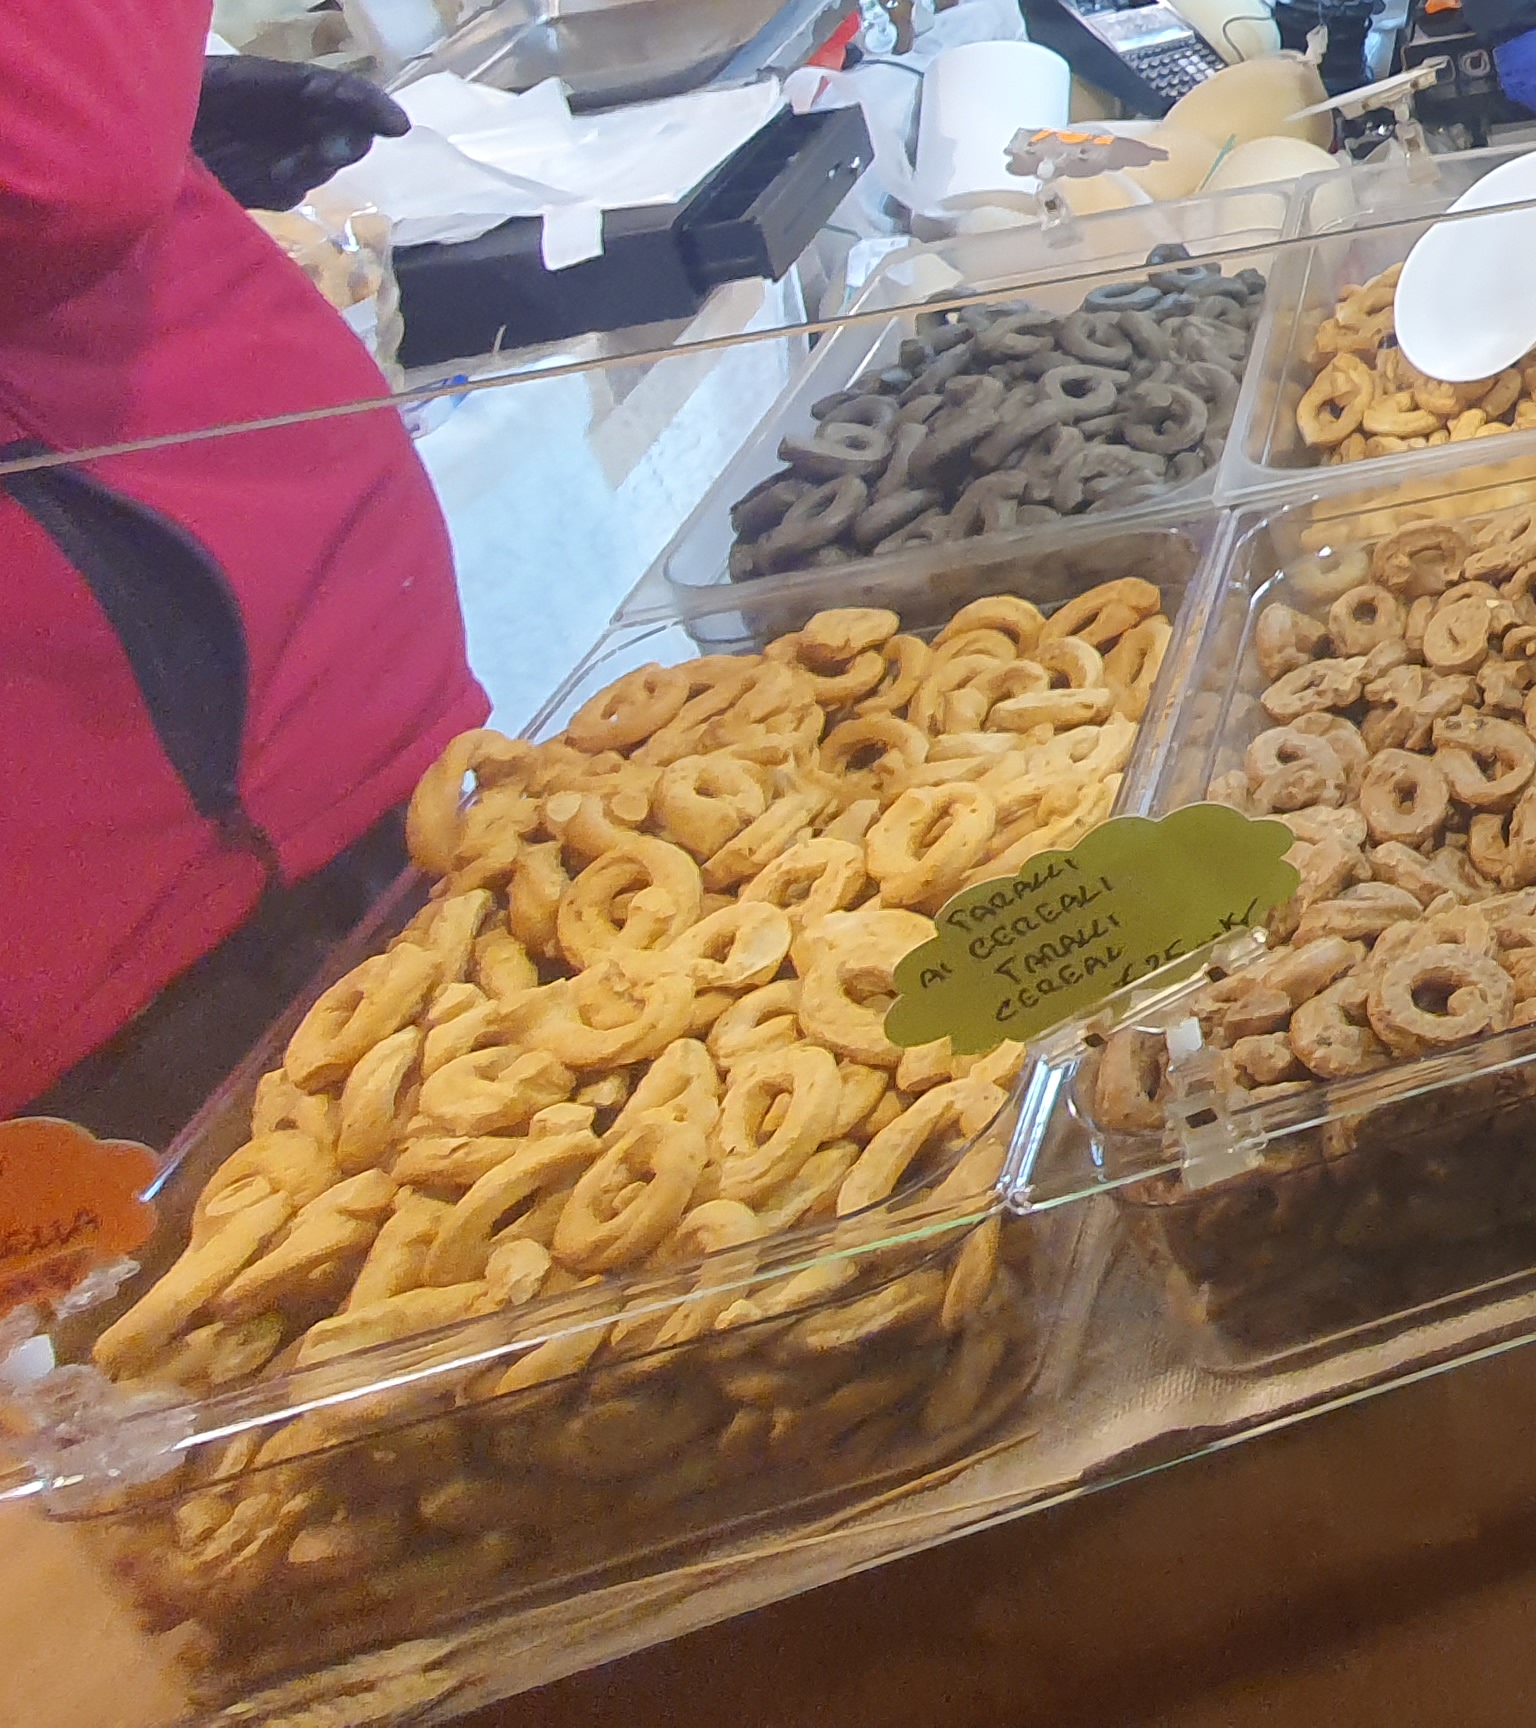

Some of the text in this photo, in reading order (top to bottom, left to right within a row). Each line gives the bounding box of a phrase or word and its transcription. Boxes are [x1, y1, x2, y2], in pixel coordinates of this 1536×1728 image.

[947, 856, 1080, 934] TARALLI
[967, 875, 1116, 960] CEREALI
[993, 911, 1122, 985] TARALLI
[994, 944, 1123, 1022] CEREAL
